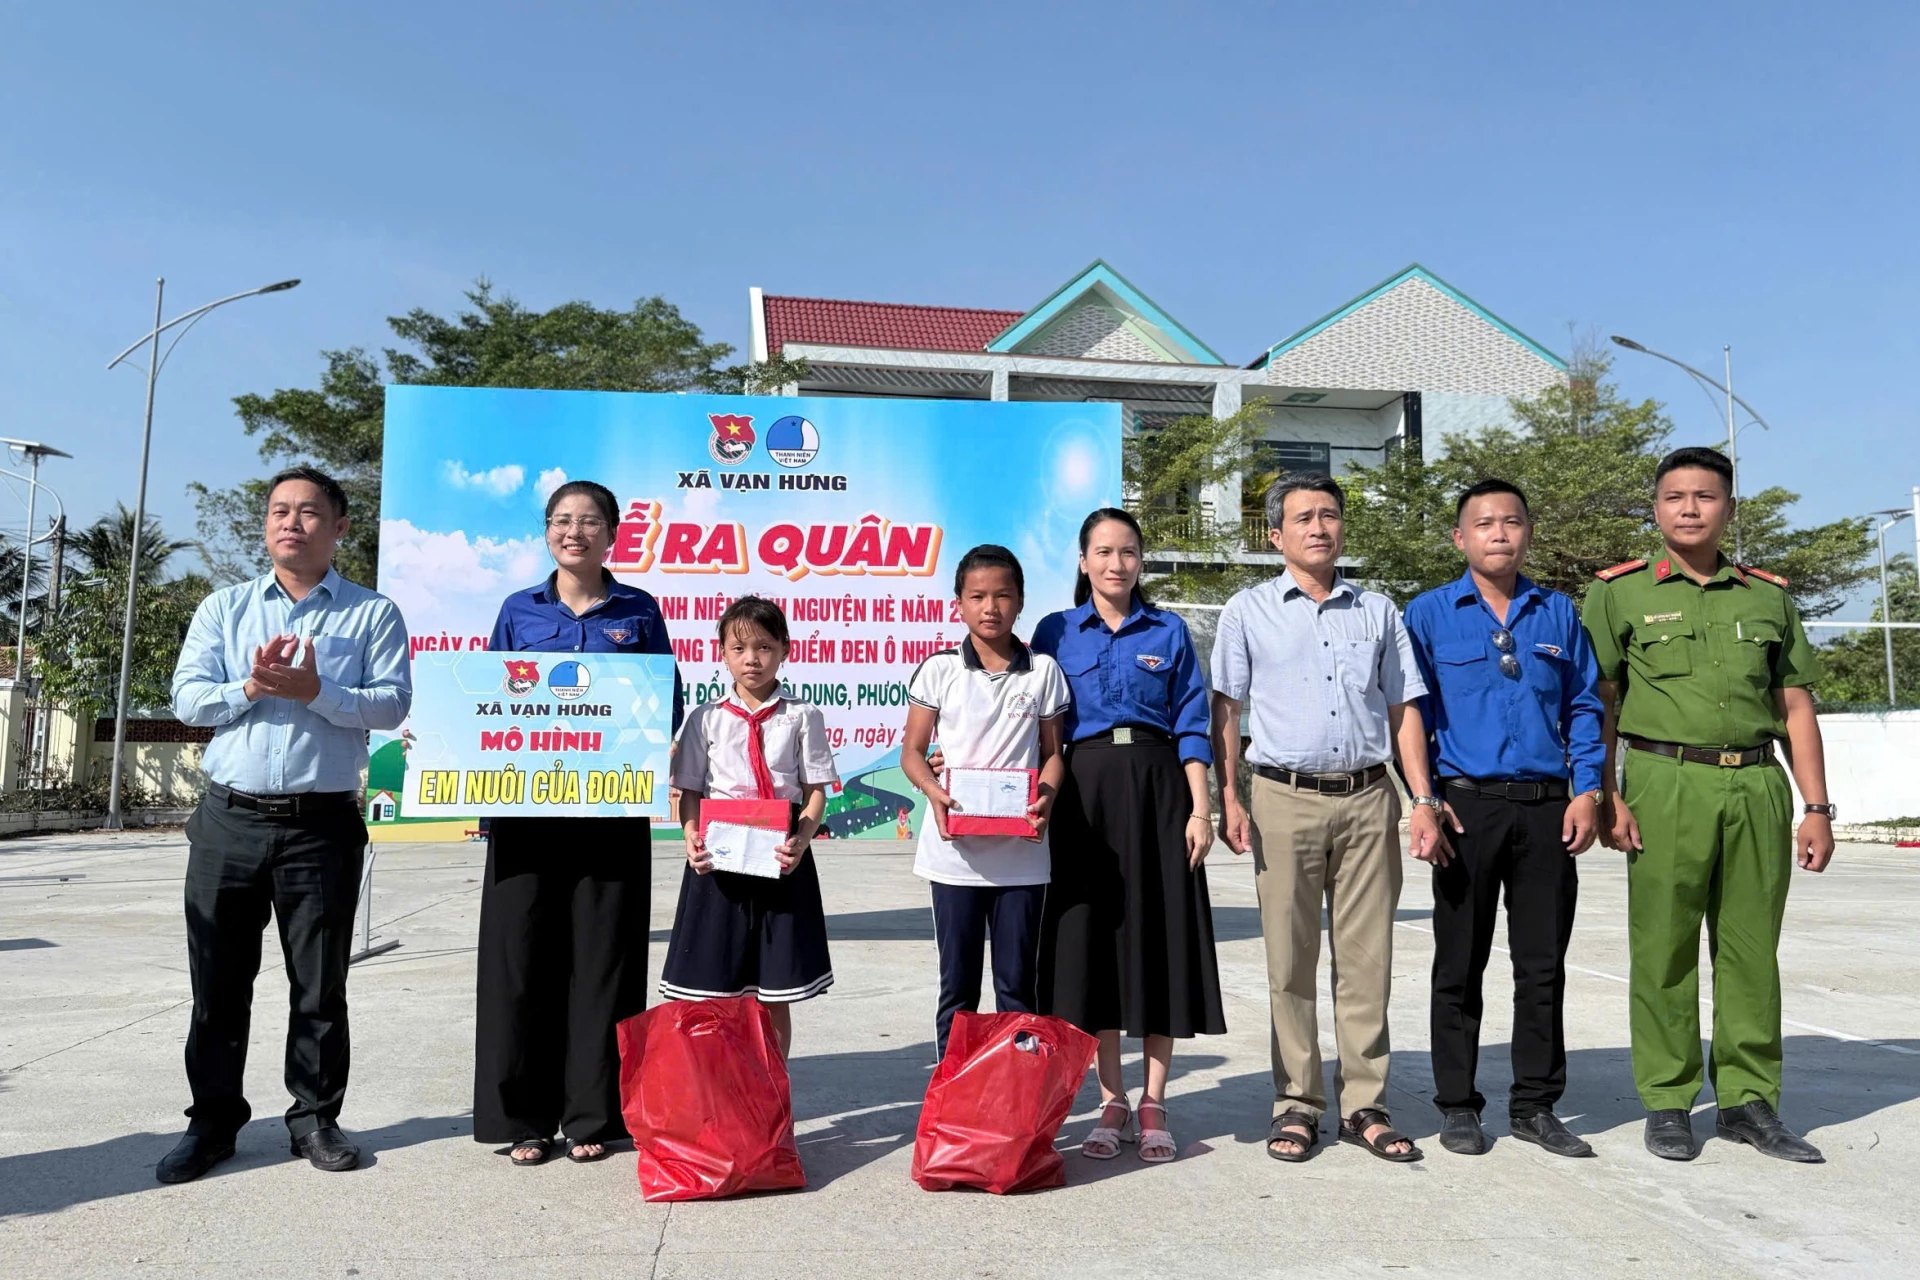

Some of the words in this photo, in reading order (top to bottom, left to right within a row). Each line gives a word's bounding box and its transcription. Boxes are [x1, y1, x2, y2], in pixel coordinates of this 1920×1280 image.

[677, 470, 712, 489] XÃ
[720, 473, 770, 493] VẠN
[778, 474, 847, 491] HƯNG
[603, 501, 655, 566] Ễ
[659, 522, 741, 568] RA
[757, 513, 935, 574] QUÂN
[793, 593, 867, 627] NGUYỆN
[872, 593, 895, 622] HÈ
[901, 594, 943, 622] NĂM
[789, 629, 835, 663] ĐIỂM
[841, 640, 878, 663] ĐEN
[884, 635, 896, 664] Ô
[476, 701, 503, 716] XÃ
[510, 703, 551, 719] VẠN
[557, 703, 612, 717] HƯNG
[802, 683, 852, 710] DUNG,
[480, 726, 524, 752] MÔ
[529, 726, 602, 752] HÌNH
[854, 723, 896, 748] ngày
[419, 770, 459, 805] EM
[464, 763, 526, 805] NUÔI
[531, 760, 581, 805] CỦA
[586, 764, 654, 805] ĐOÀN
